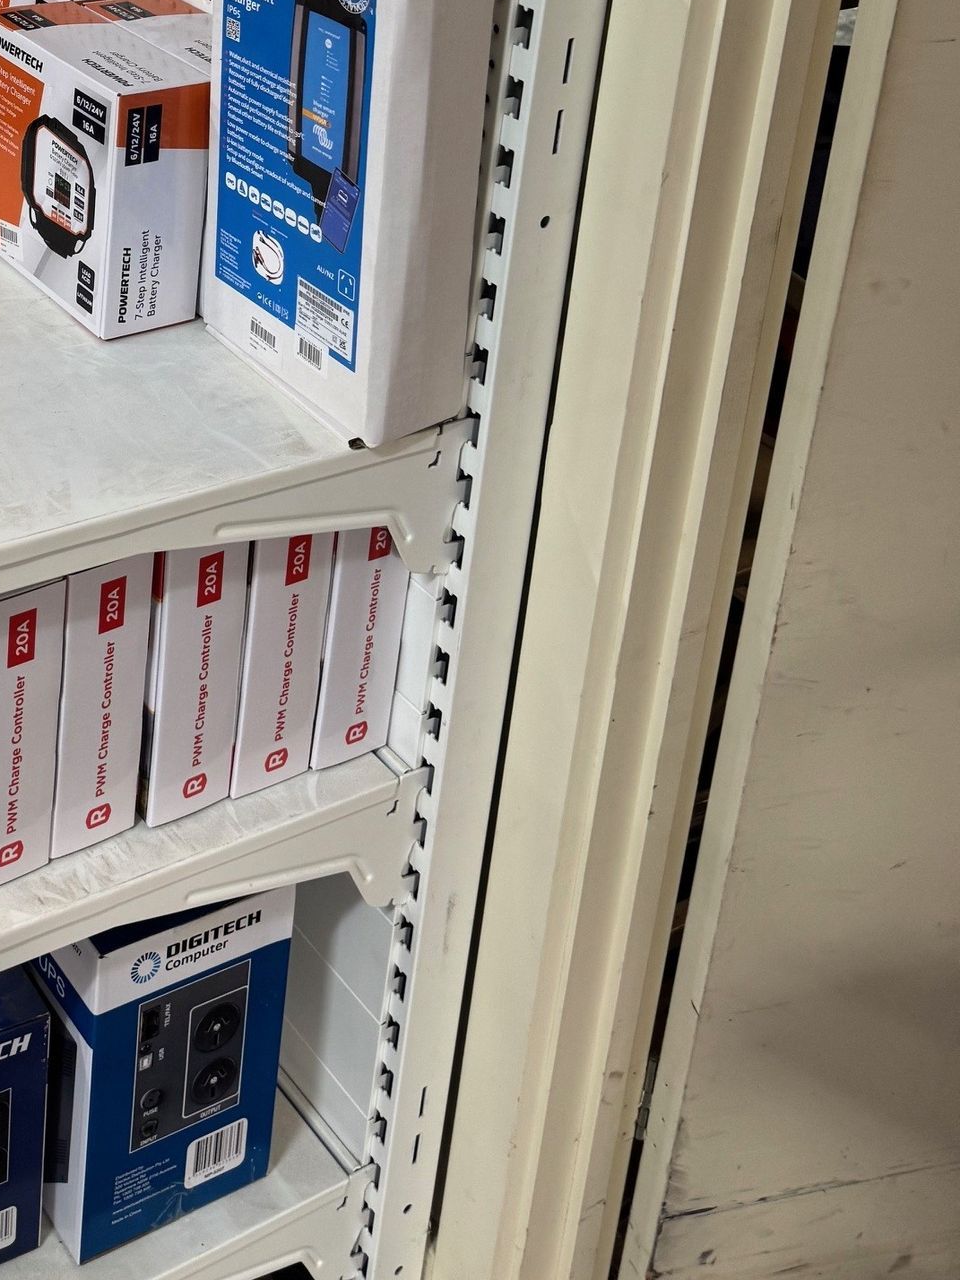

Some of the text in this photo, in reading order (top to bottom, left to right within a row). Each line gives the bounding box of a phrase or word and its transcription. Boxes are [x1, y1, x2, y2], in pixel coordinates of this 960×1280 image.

[227, 5, 241, 18] IP65
[9, 74, 36, 96] Intelligent
[82, 58, 133, 87] POWERTECH
[10, 86, 32, 106] Charger
[76, 95, 104, 118] 6/12/24V
[82, 120, 95, 135] 16A
[130, 113, 140, 161] 6/12/24V
[149, 124, 158, 144] 16A
[51, 140, 79, 165] POWERTECH
[81, 267, 92, 279] LEAD
[118, 248, 131, 324] POWERTECH
[135, 229, 150, 320] 7-Step Intelligent
[147, 235, 162, 318] Battery Charger
[354, 530, 388, 715] PWM Charge Controller 20
[274, 541, 307, 742] PWM Charge Controller 20A
[191, 561, 218, 767] PWM Charge Controller 20A
[94, 586, 120, 798] PWM Charge Controller 20A
[5, 618, 31, 835] PWM Charge Controller 20A
[166, 909, 263, 959] DIGITECH
[165, 938, 228, 972] Computer
[39, 956, 65, 998] UPS
[143, 1107, 158, 1117] FUSE
[200, 1104, 222, 1119] OUTPUT
[140, 1134, 158, 1147] INPUT
